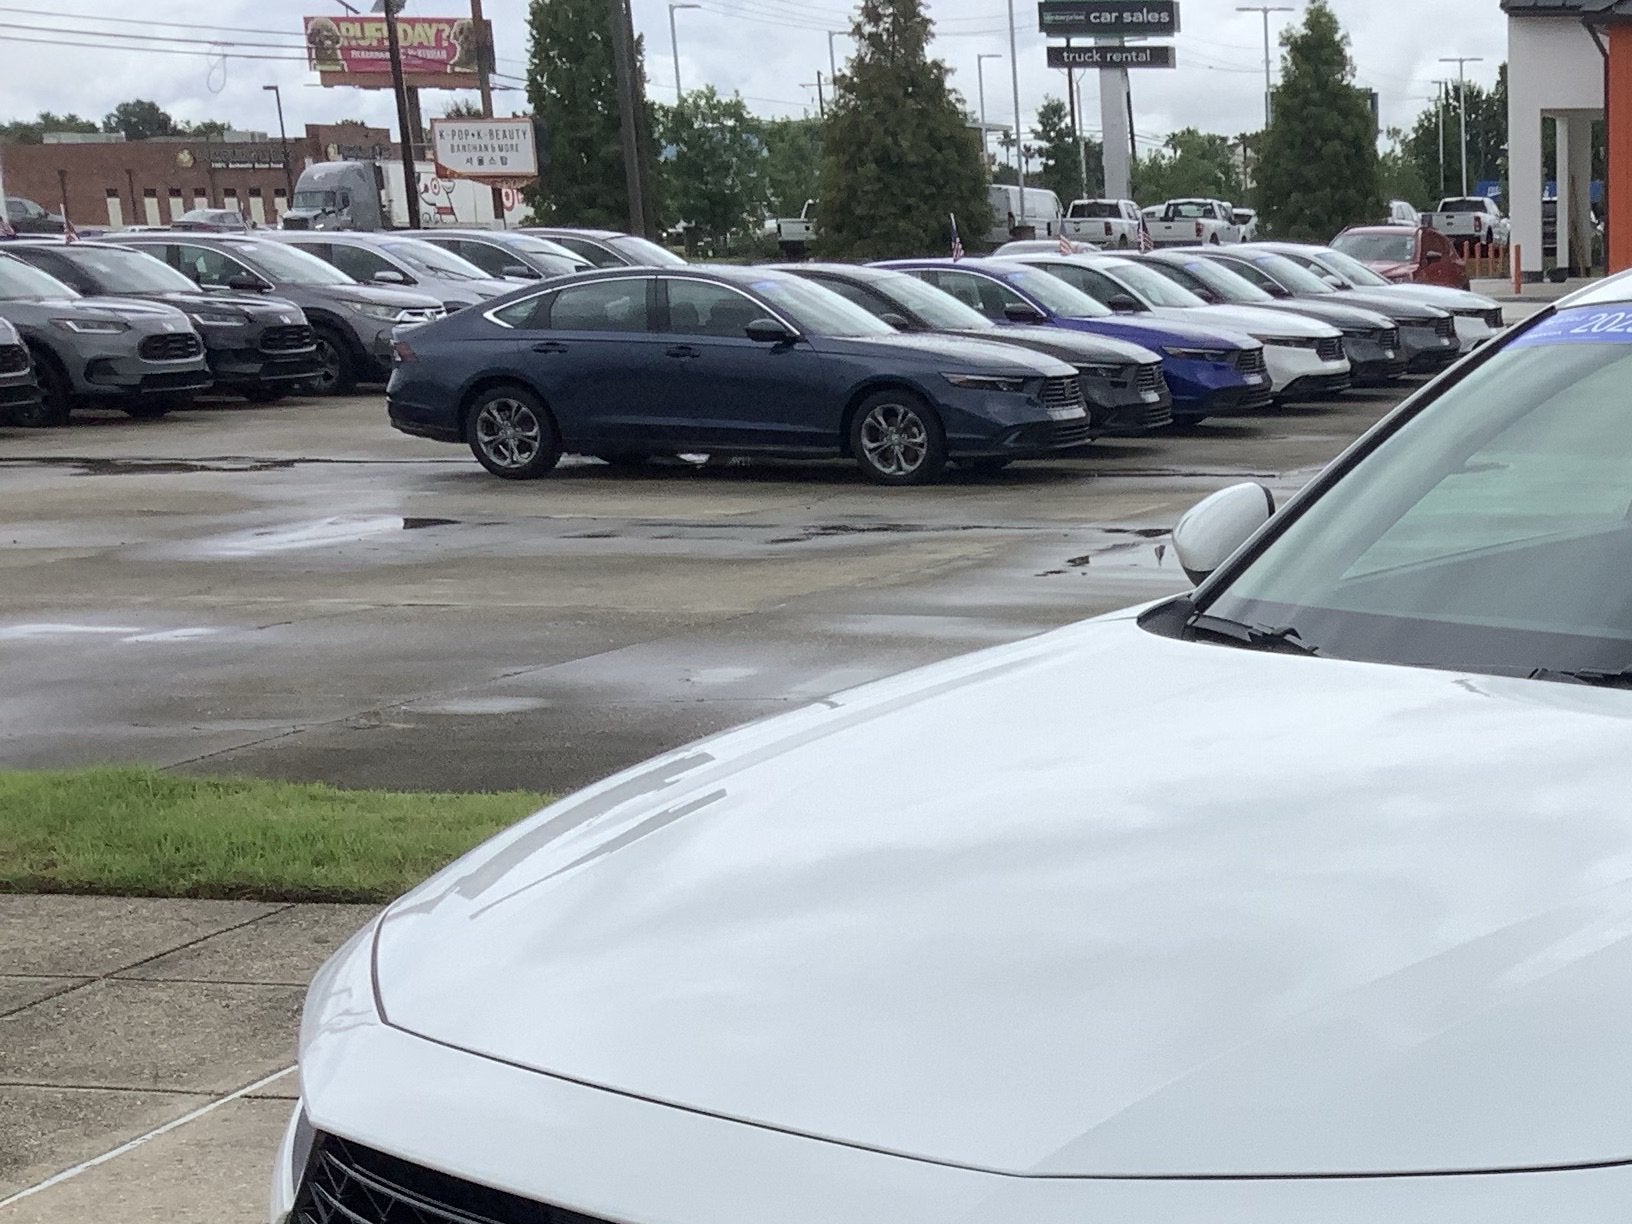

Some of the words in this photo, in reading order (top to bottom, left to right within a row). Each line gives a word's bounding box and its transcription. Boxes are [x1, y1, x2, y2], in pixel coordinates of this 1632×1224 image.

[1089, 11, 1119, 23] car
[1122, 6, 1170, 23] sales
[396, 22, 450, 47] DAY?
[1062, 48, 1102, 62] truck
[1106, 48, 1151, 62] rental
